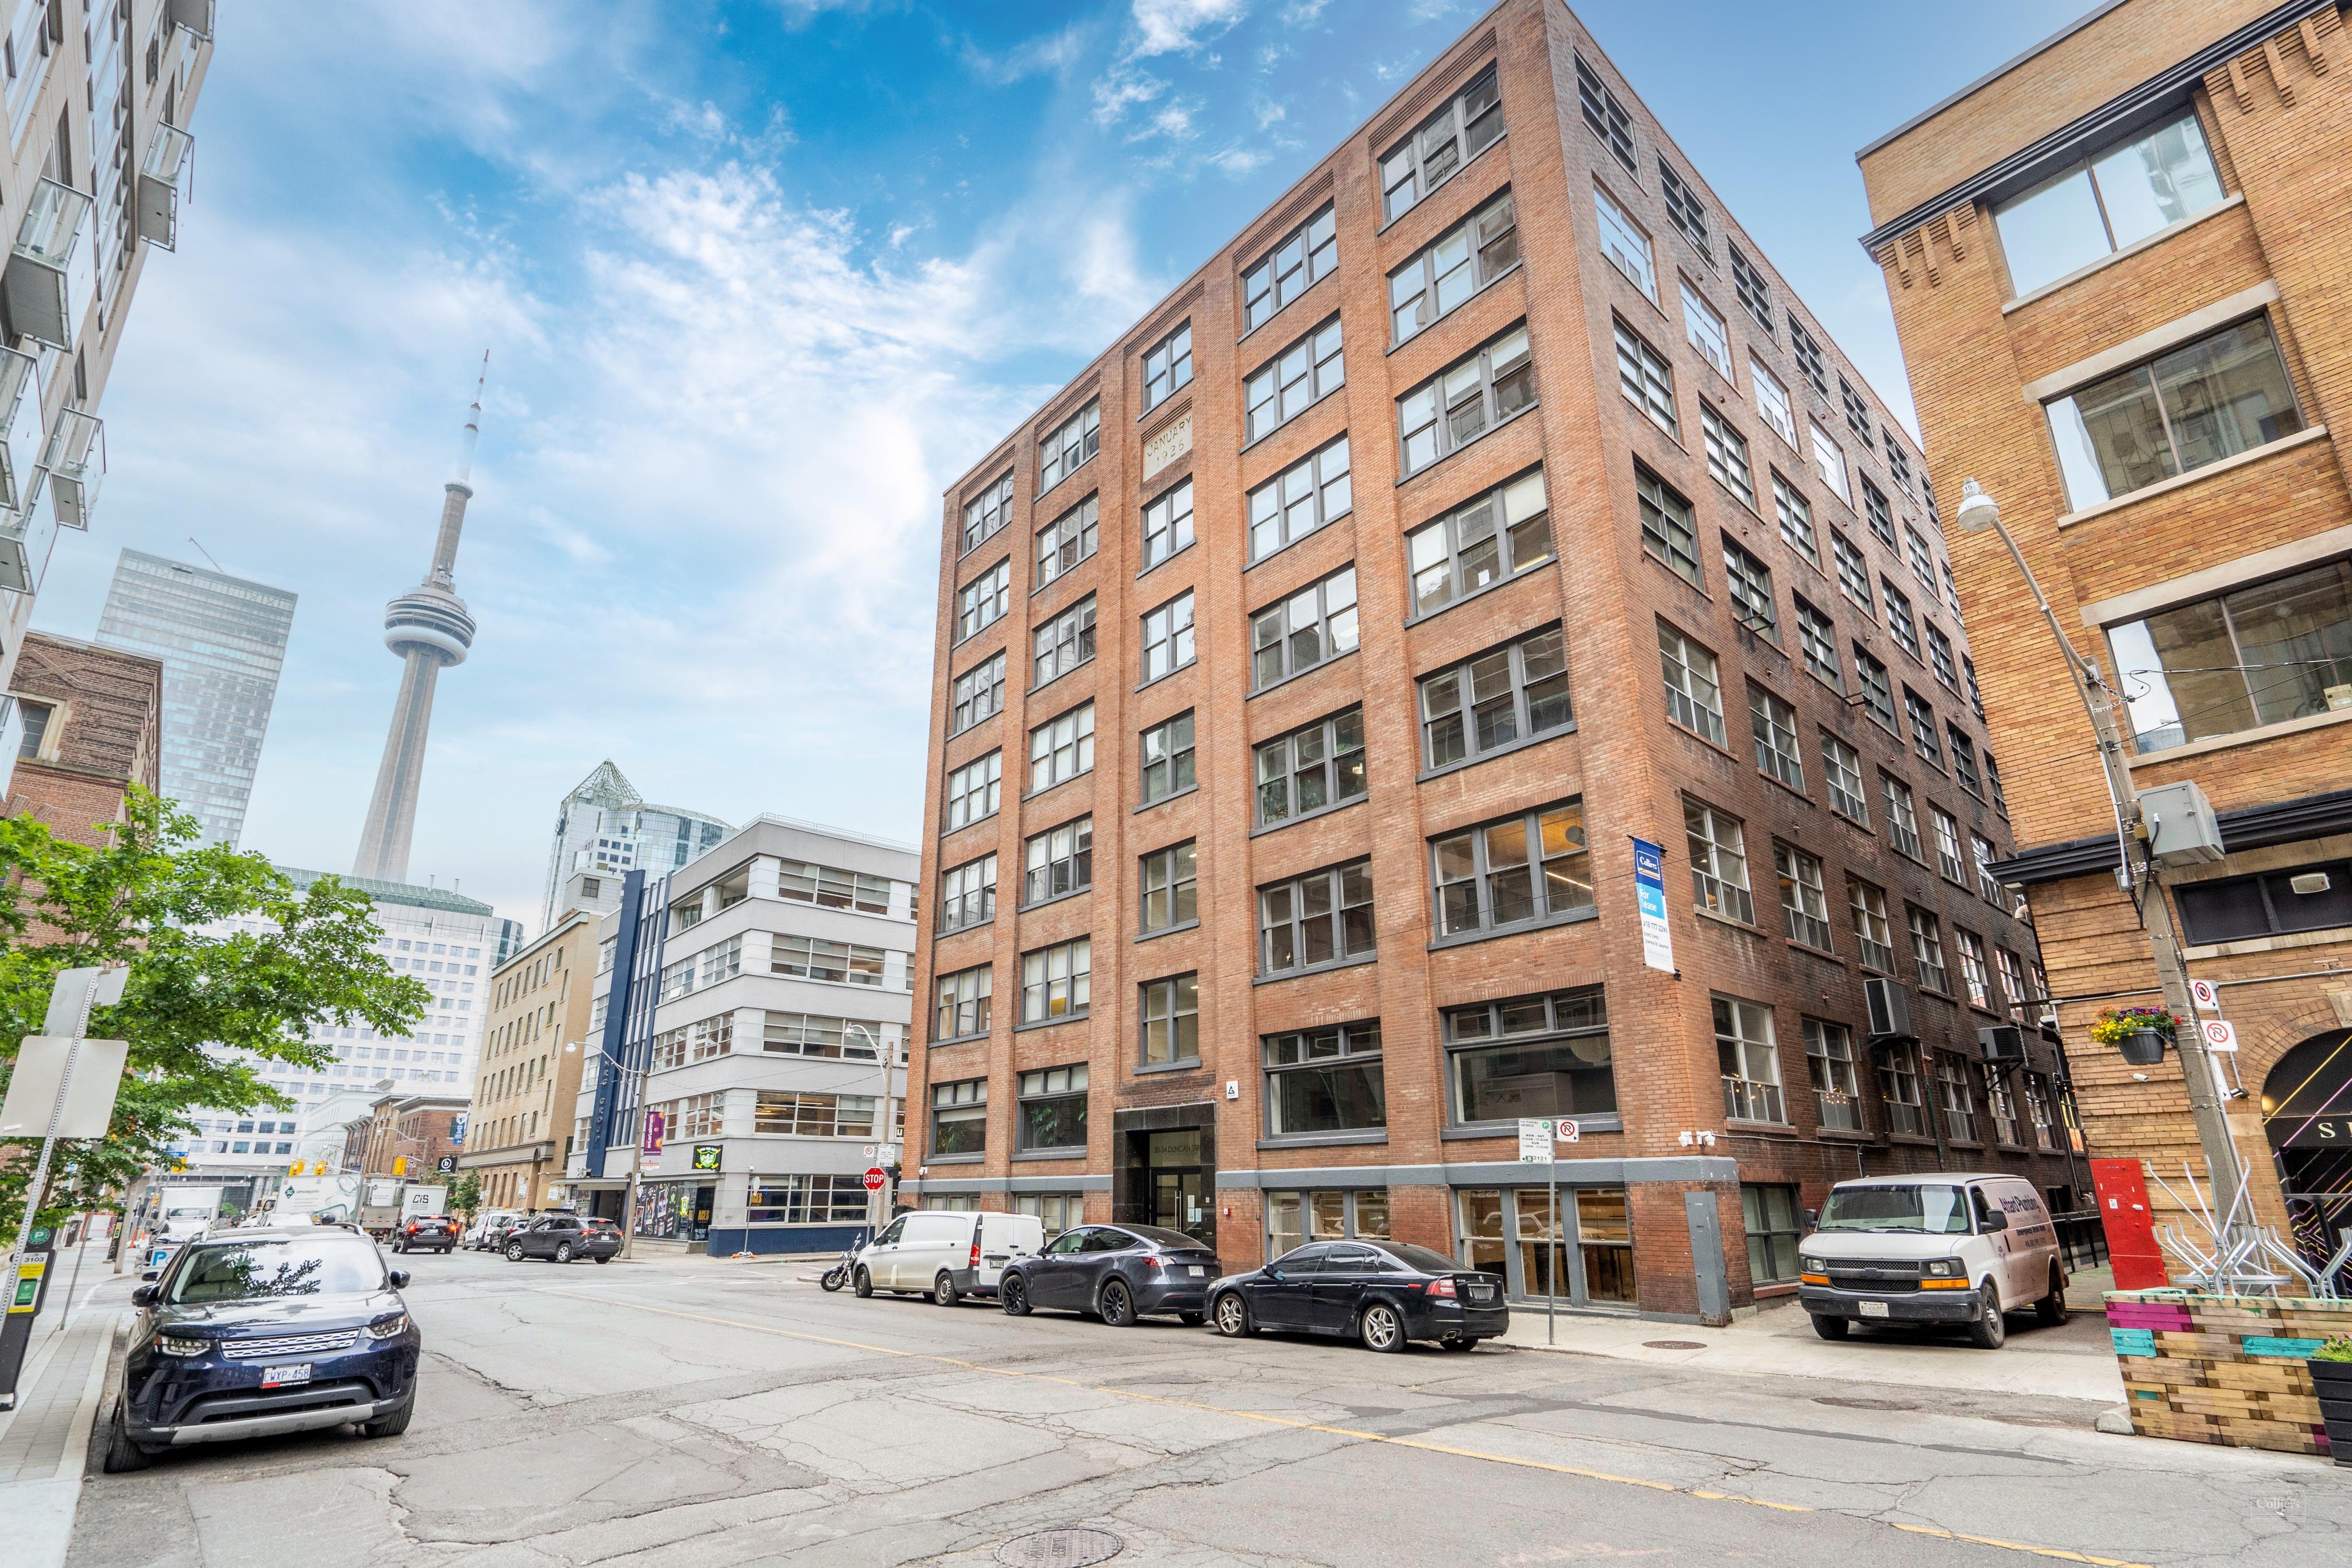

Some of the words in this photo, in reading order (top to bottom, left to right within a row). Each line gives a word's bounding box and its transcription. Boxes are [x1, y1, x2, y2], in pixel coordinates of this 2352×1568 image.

[1147, 415, 1192, 457] JANUARY
[1156, 438, 1185, 467] 1926
[1639, 856, 1657, 869] Colliers
[1639, 888, 1650, 899] for
[1641, 897, 1657, 912] lease
[594, 1097, 606, 1143] GROUP
[1168, 1145, 1190, 1153] DUNCAN
[865, 1174, 884, 1183] STOP
[2013, 1194, 2041, 1213] Plumbing
[264, 1370, 287, 1382] CWXP
[292, 1368, 309, 1379] 458
